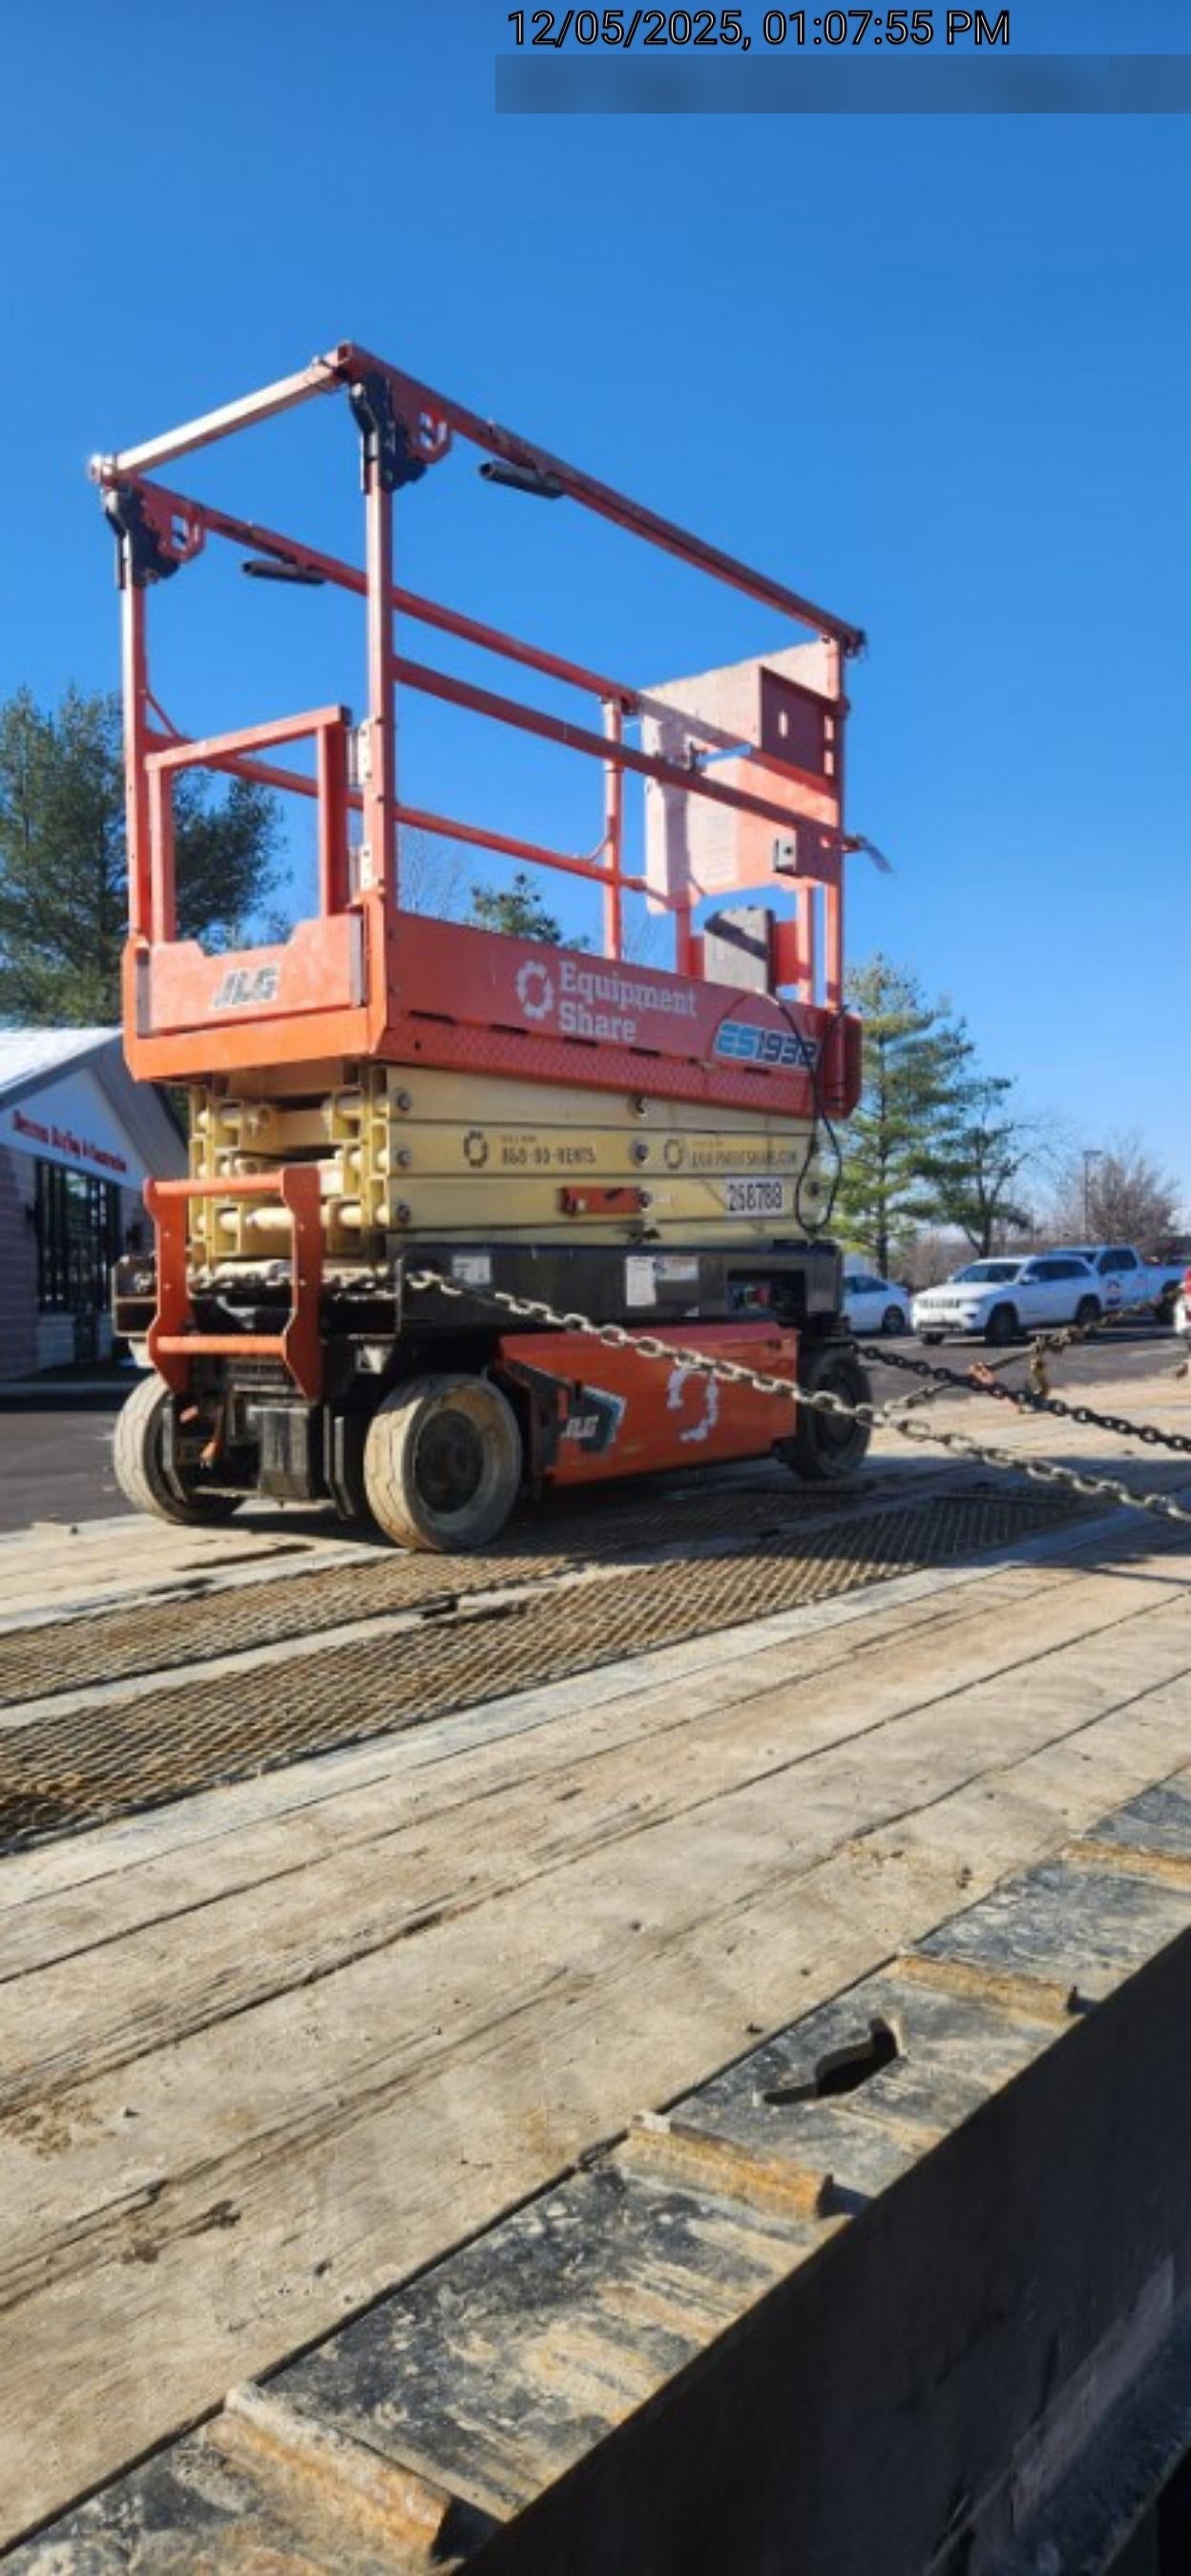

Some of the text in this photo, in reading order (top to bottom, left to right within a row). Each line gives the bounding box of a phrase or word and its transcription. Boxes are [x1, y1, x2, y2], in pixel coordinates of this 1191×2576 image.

[213, 966, 279, 1008] JLG
[558, 960, 696, 1018] Equipment
[558, 1001, 637, 1043] Share
